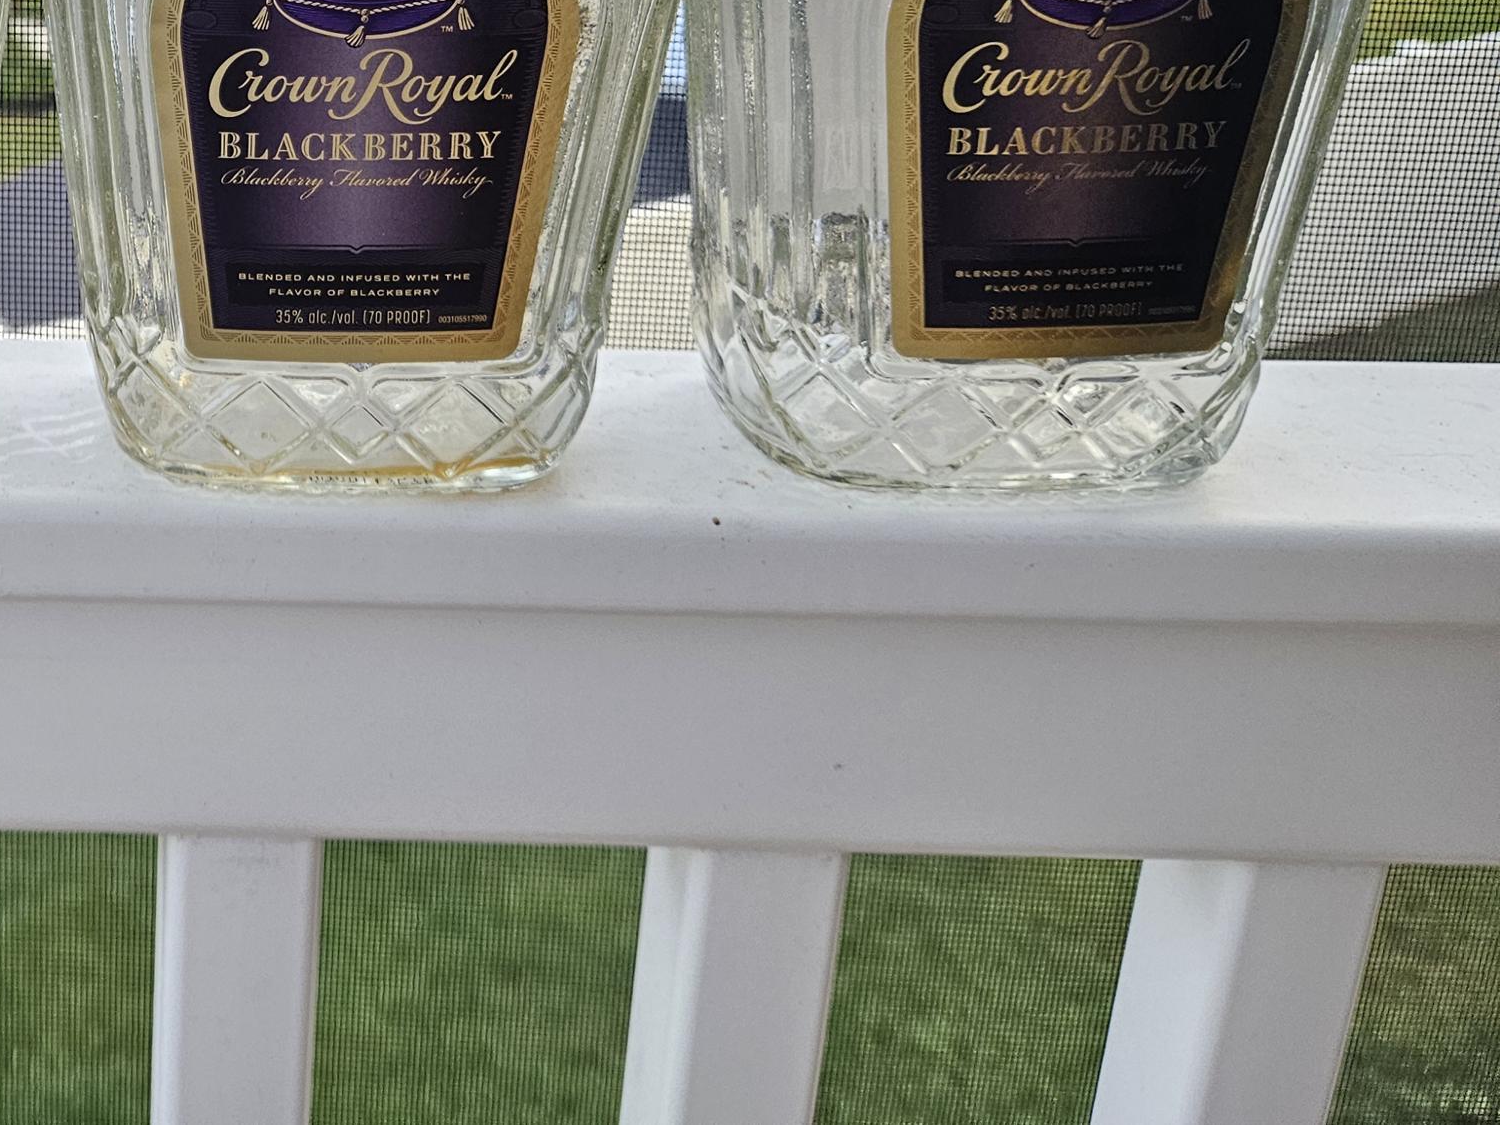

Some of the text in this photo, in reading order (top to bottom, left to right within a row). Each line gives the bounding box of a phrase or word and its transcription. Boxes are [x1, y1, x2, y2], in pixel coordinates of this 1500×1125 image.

[208, 47, 355, 121] Crown
[328, 49, 518, 125] Royal
[942, 39, 1250, 115] Crown Royal
[217, 130, 501, 162] BLACKBERRY
[946, 121, 1227, 156] BLACKBERRY
[220, 166, 494, 200] Blackberry Flavored Whisky
[946, 163, 1049, 195] Blackberry
[238, 273, 301, 282] BLENDED
[307, 274, 335, 282] AND
[405, 274, 439, 282] WITH
[444, 273, 470, 281] THE
[955, 270, 1020, 278] BLENDED
[1025, 269, 1053, 277] AND
[1058, 268, 1116, 276] INFUSED
[1159, 264, 1182, 272] THE
[269, 288, 440, 297] FLAVOR OF BLACKBERRY
[984, 281, 1153, 292] FLAVOR OF BLACKBERRY
[275, 309, 304, 324] 35%
[308, 309, 358, 325] alc./vol.
[362, 309, 382, 325] (70
[387, 309, 431, 325] PROOF)
[988, 305, 1017, 320] 35%
